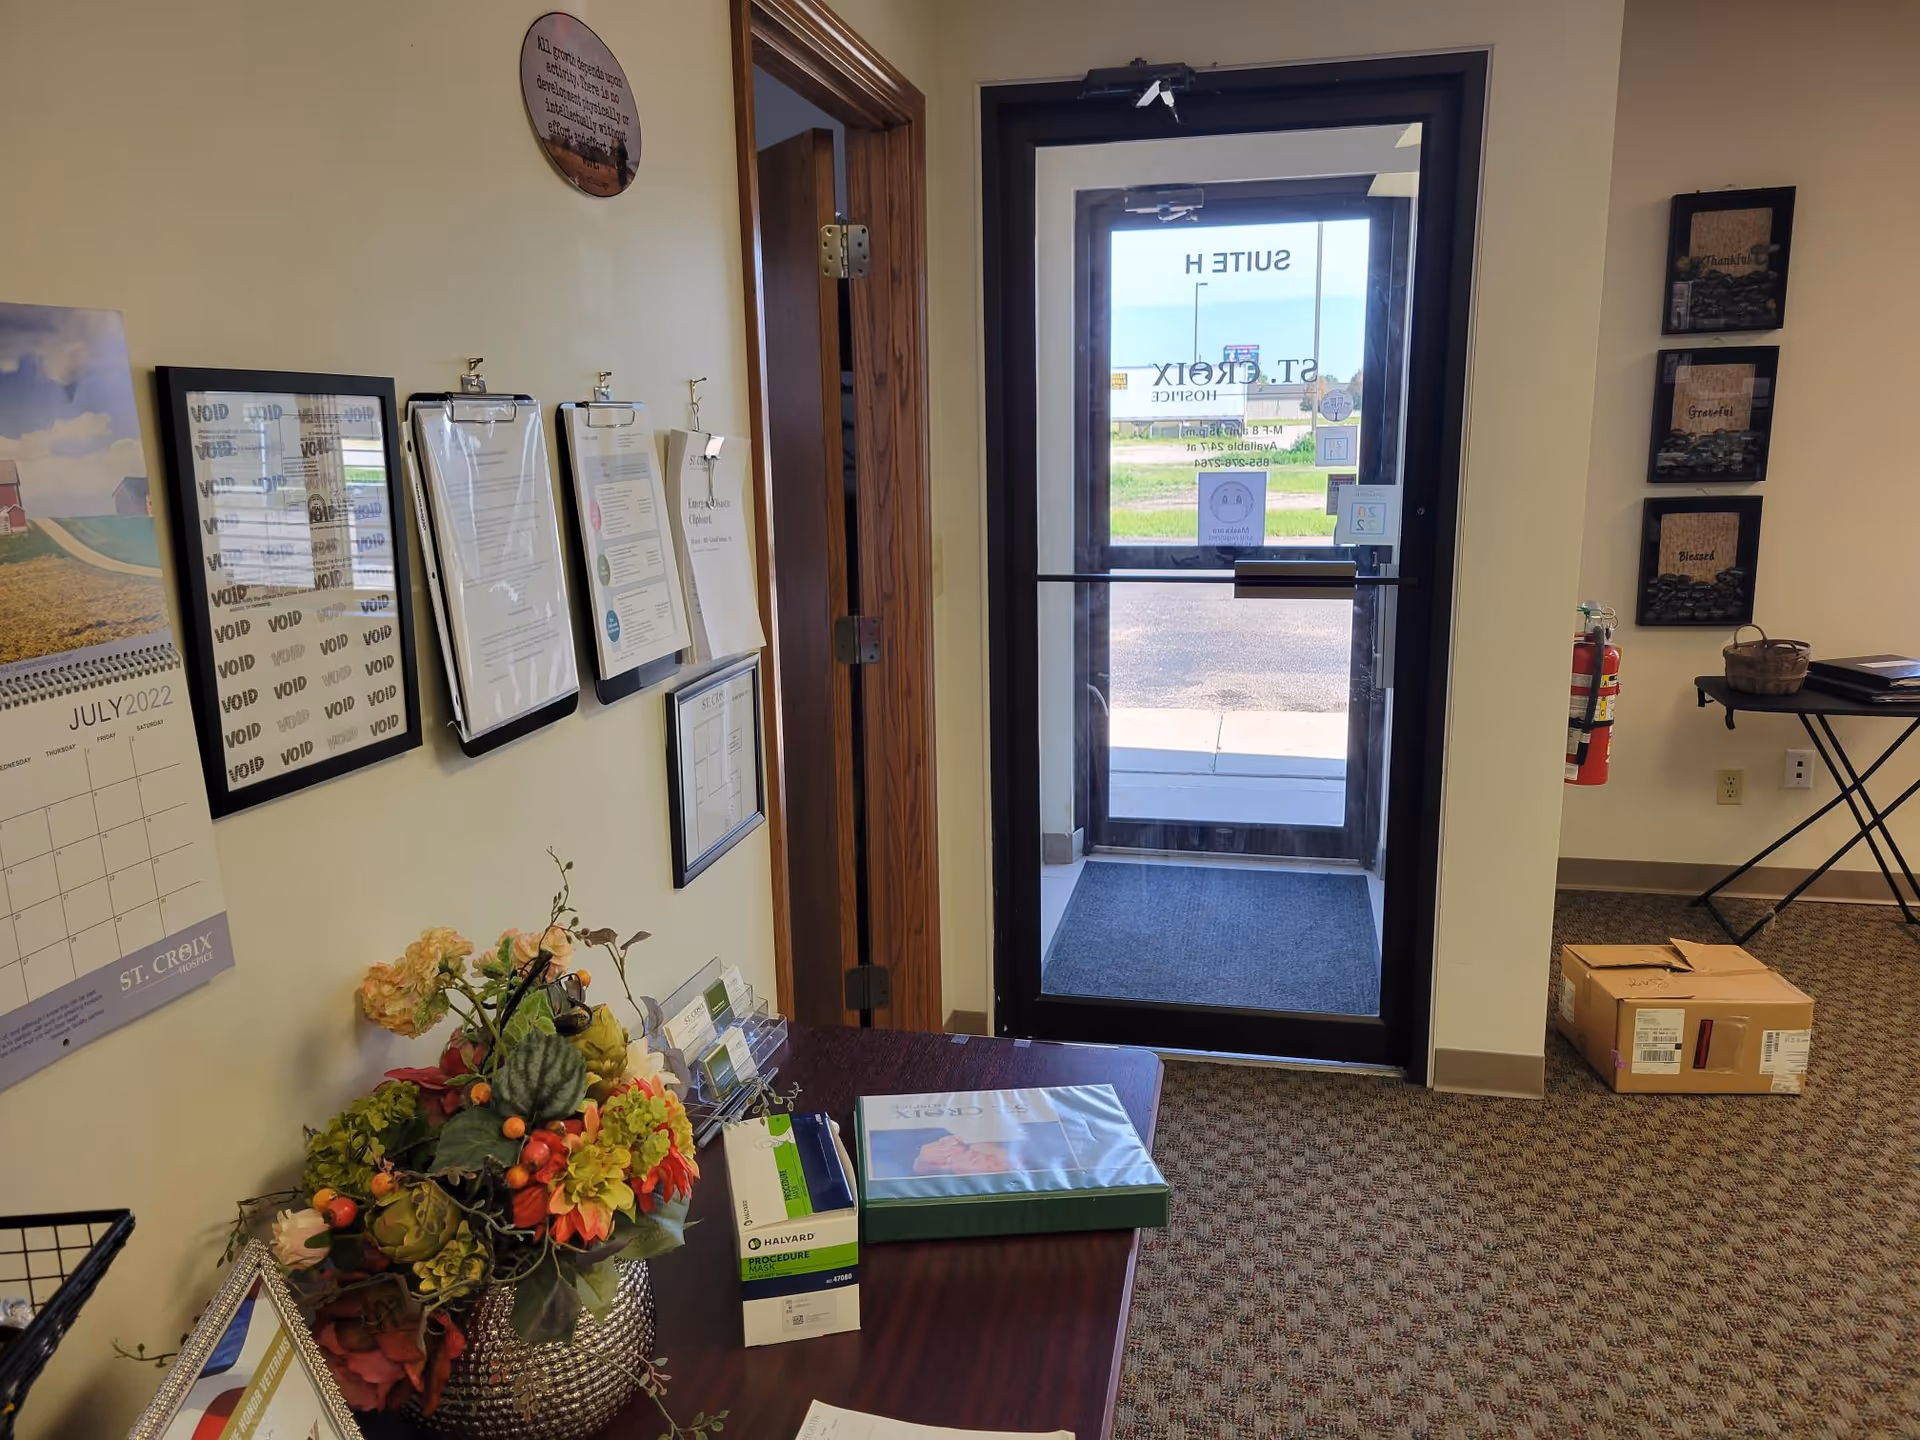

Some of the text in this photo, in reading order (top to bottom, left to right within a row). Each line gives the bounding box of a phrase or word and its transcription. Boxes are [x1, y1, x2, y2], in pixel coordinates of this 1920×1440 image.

[537, 34, 622, 89] All growth depends upon
[546, 62, 620, 105] activity. There is no
[545, 98, 627, 143] intellectually without
[581, 96, 621, 125] physically
[623, 114, 629, 126] or
[1702, 253, 1751, 266] Thankful
[191, 403, 230, 422] VOID
[1688, 405, 1733, 419] Grateful
[357, 533, 386, 551] VOID
[1678, 551, 1715, 562] Blessed
[314, 570, 343, 590] VOID
[211, 584, 247, 607] VOID
[360, 594, 390, 613] VOID
[214, 619, 251, 643] VOID
[268, 610, 303, 633] VOID
[320, 633, 349, 656] VOID
[363, 625, 392, 646] VOID
[218, 653, 256, 679] VOID
[365, 655, 395, 676] VOID
[274, 675, 307, 700] VOID
[367, 685, 397, 707] VOID
[221, 688, 258, 714] VOID
[324, 696, 355, 719] VOID
[225, 722, 262, 748] VOID
[370, 714, 399, 737] VOID
[0, 720, 164, 771] EDNESDAY THURSDAY FRIDAY SATURDAY
[280, 740, 314, 766] VOID
[228, 755, 265, 783] VOID
[120, 931, 213, 991] ST. CROIX
[178, 951, 213, 975] HOSPICE
[764, 1233, 814, 1246] HALYARD
[749, 1251, 810, 1266] PROCEDURE
[749, 1264, 777, 1273] MASK
[238, 1389, 263, 1433] HONOR
[259, 1336, 291, 1392] VETERANS
